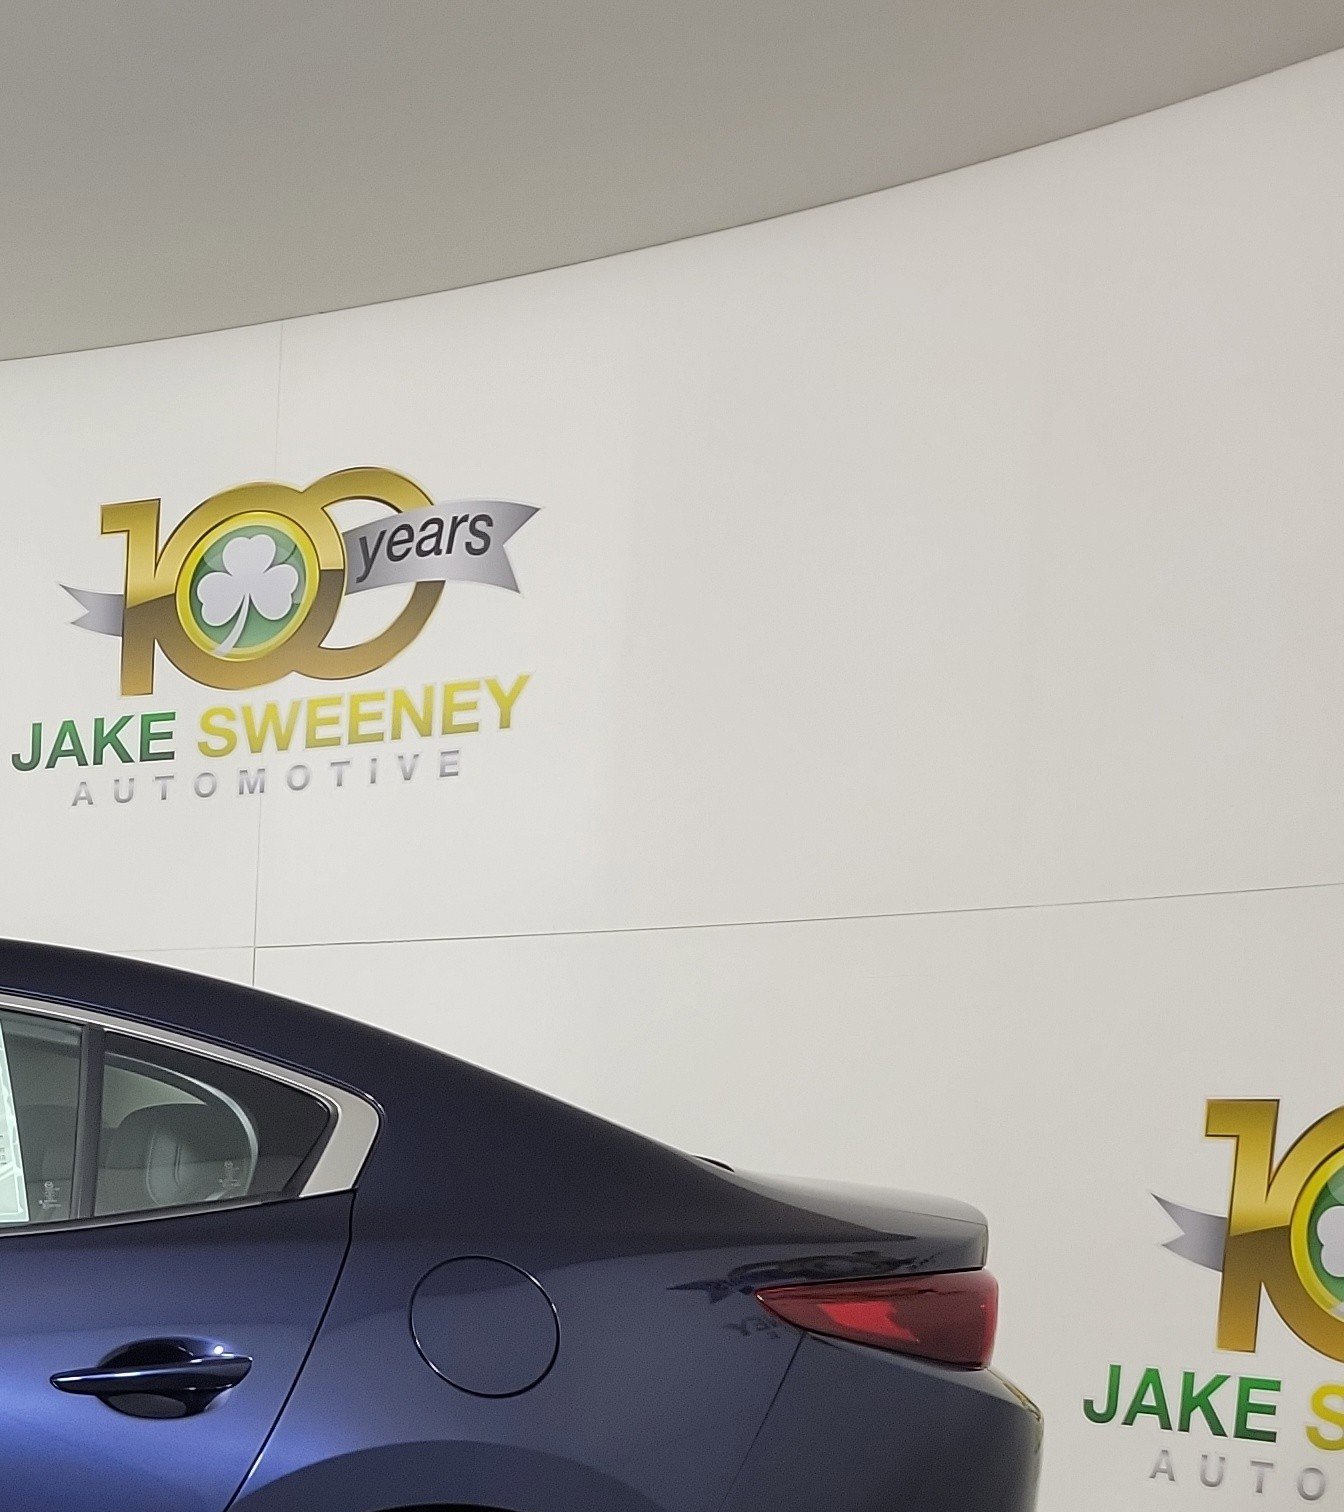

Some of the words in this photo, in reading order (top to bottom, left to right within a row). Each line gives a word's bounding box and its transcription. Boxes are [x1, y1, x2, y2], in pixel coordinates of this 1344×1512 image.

[100, 466, 446, 697] 100
[355, 510, 493, 584] years
[11, 711, 177, 772] JAKE
[197, 674, 531, 759] SWEENEY
[71, 749, 461, 807] AUTOMOTIVE
[1083, 1363, 1282, 1443] JAKE
